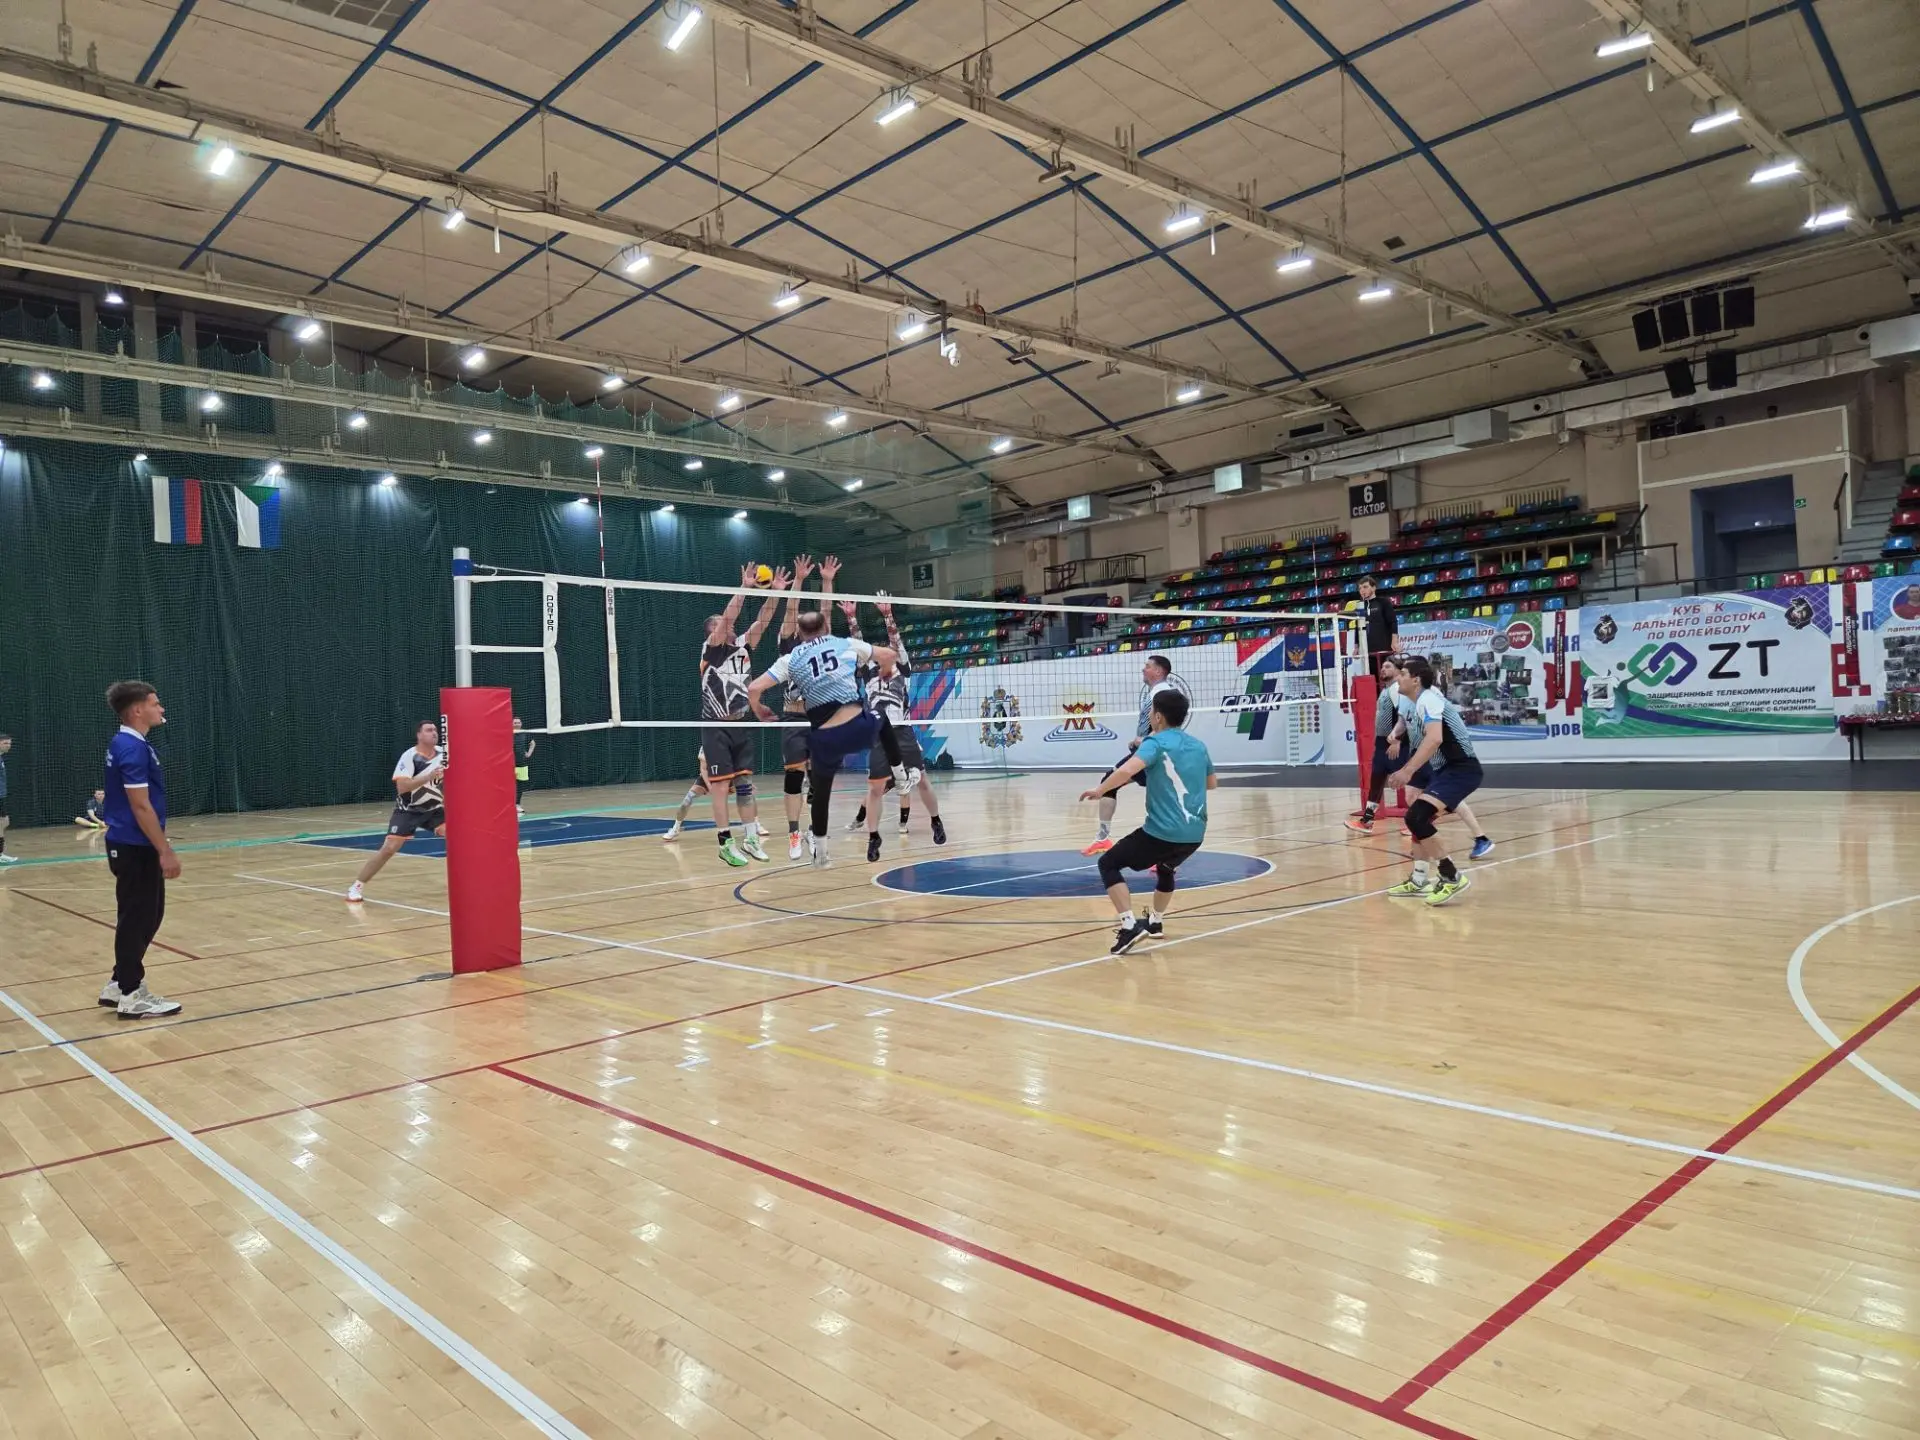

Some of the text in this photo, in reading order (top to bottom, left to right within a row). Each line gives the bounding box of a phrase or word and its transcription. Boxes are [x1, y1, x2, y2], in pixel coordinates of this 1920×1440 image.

[1363, 485, 1373, 503] 6
[1352, 502, 1386, 517] СЕКТОР
[920, 566, 927, 580] 5
[1633, 611, 1766, 632] ДАЛЬНЕГО ВОСТОКА
[1442, 628, 1494, 640] Шарапов
[1647, 624, 1751, 640] ПО ВОЛЕЙБОЛУ
[730, 655, 745, 674] 17
[807, 649, 839, 677] 15
[1716, 686, 1816, 696] ТЕЛЕКОММУНИКАЦИИ
[1772, 698, 1816, 706] СОХРАНИТЬ
[711, 765, 718, 775] 17
